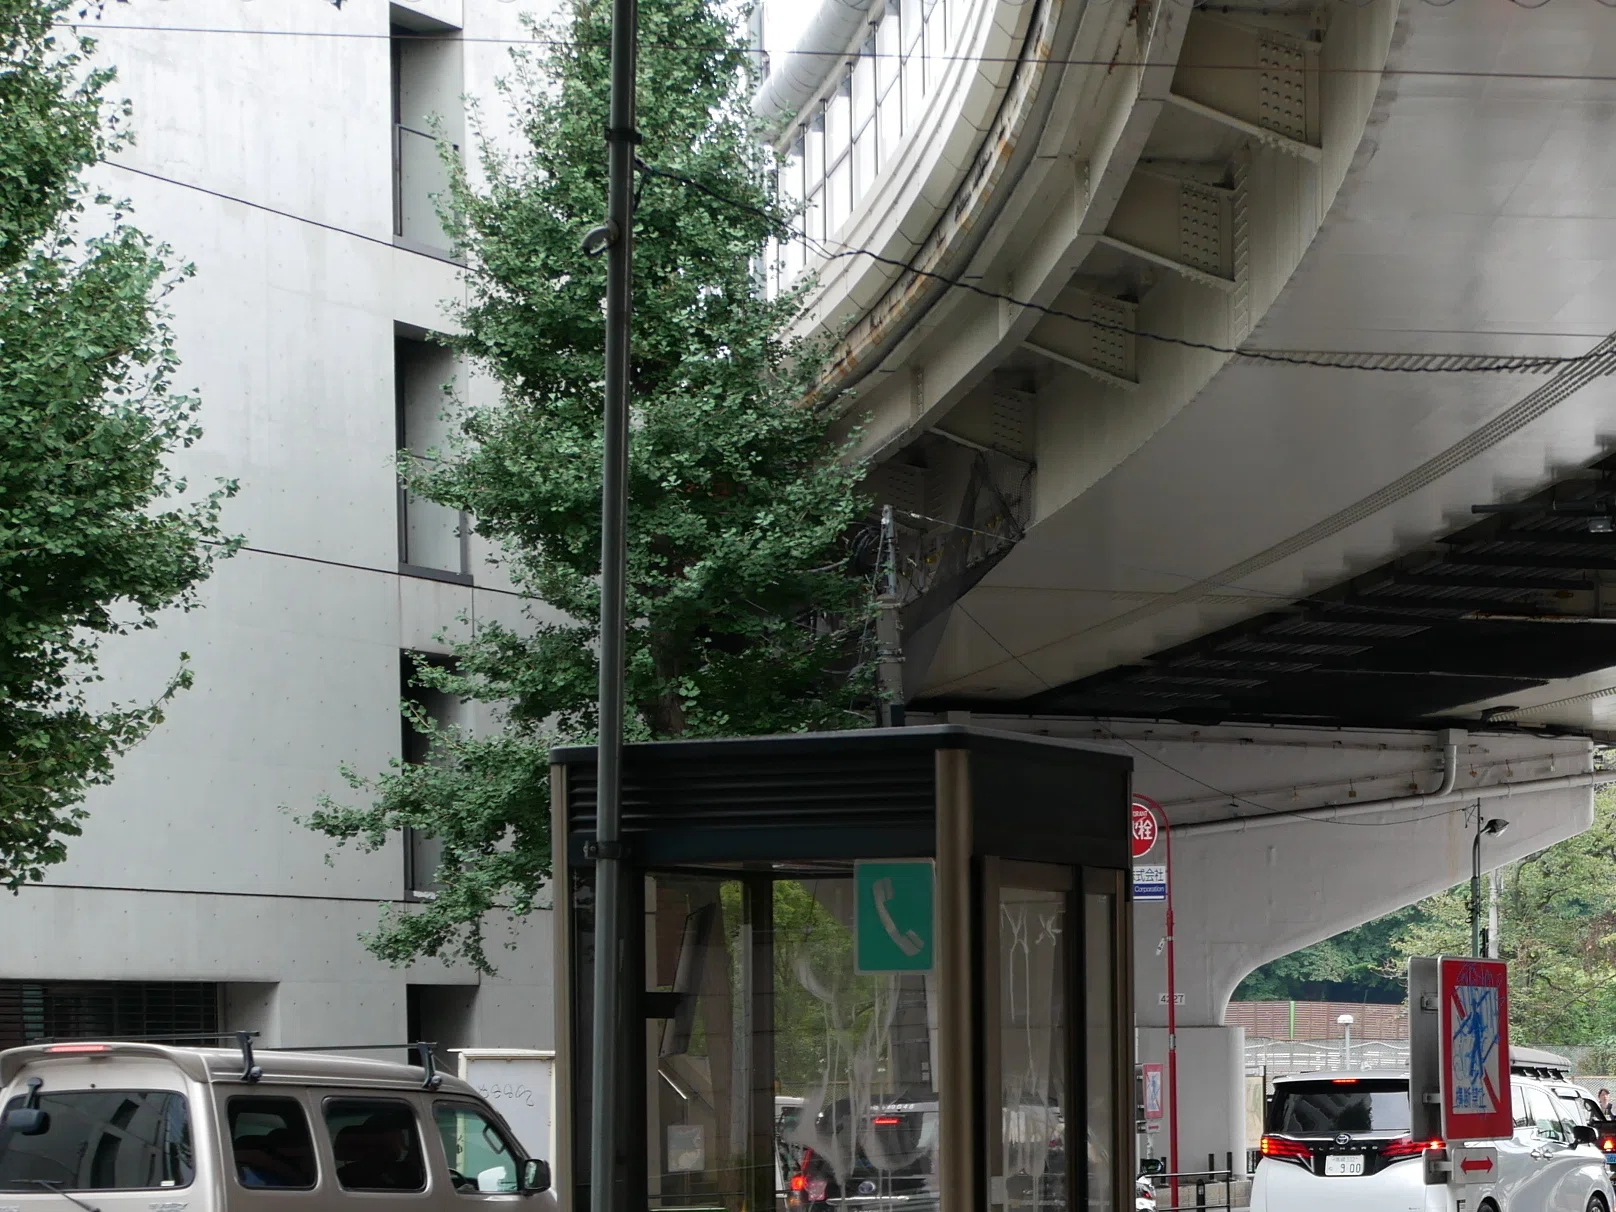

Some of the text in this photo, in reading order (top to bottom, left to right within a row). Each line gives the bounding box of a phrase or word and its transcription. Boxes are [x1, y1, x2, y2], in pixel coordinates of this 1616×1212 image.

[1133, 868, 1164, 882] 式会社
[1135, 885, 1164, 893] Corporation
